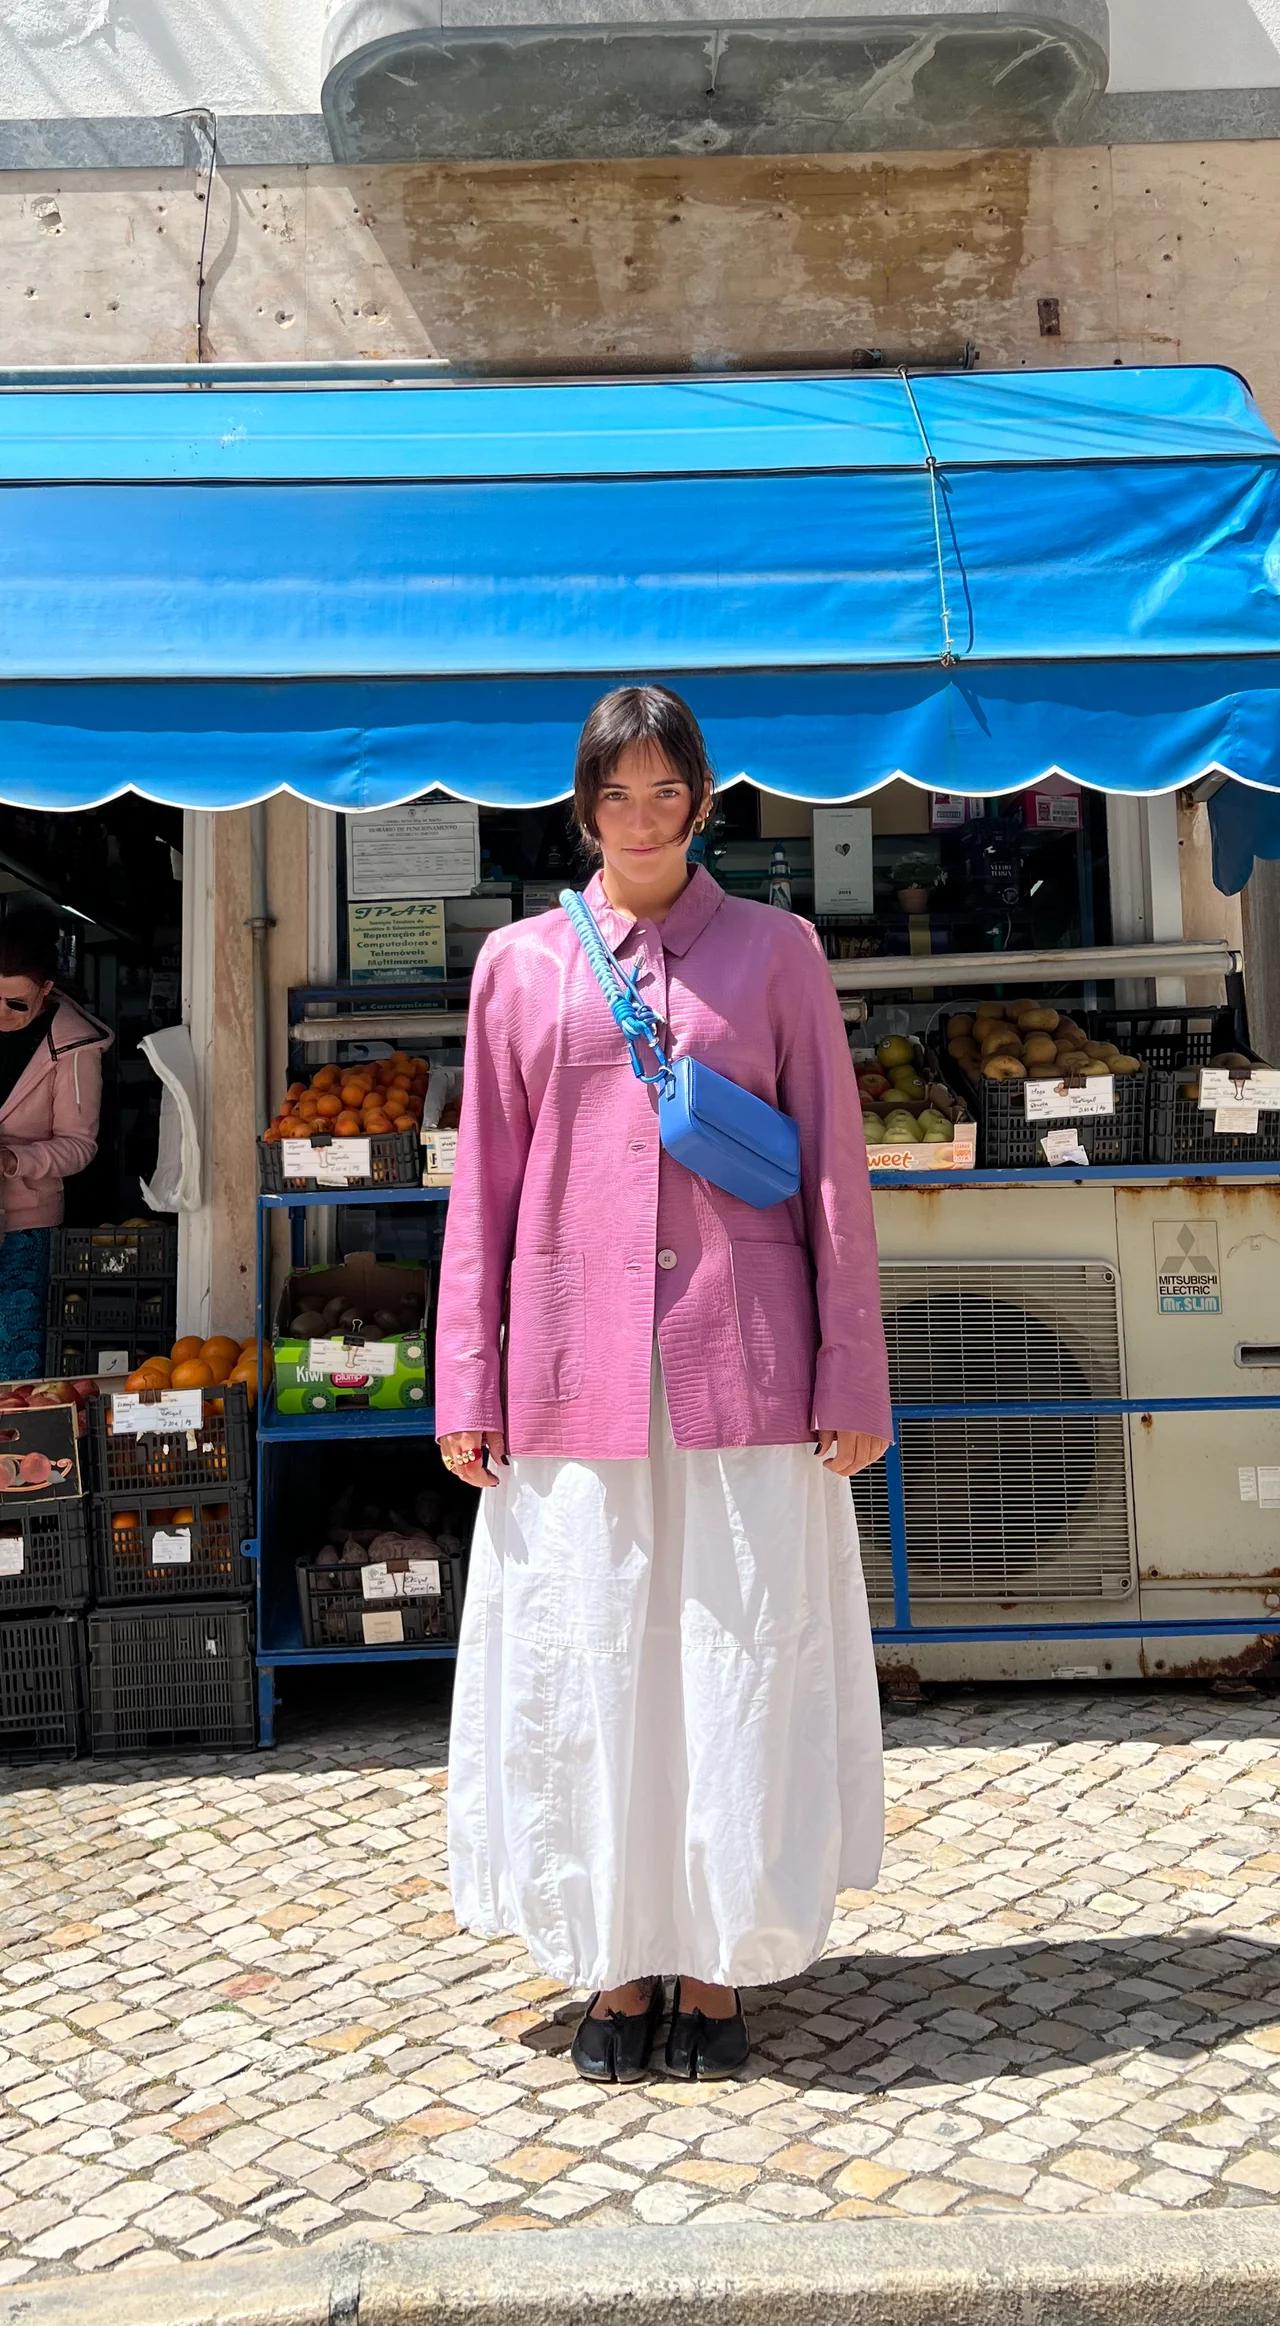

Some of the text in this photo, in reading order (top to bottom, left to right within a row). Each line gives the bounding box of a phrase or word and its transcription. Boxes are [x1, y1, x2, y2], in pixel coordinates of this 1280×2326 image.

[363, 932, 416, 940] Reparação
[357, 940, 429, 949] Computadores
[370, 949, 425, 957] Telemóveis
[368, 959, 429, 967] Multimarcas
[867, 1152, 913, 1169] weet
[1158, 1275, 1218, 1285] MITSUBISHI
[1159, 1286, 1211, 1296] ELECTRIC
[296, 1365, 363, 1384] Kiwi plump
